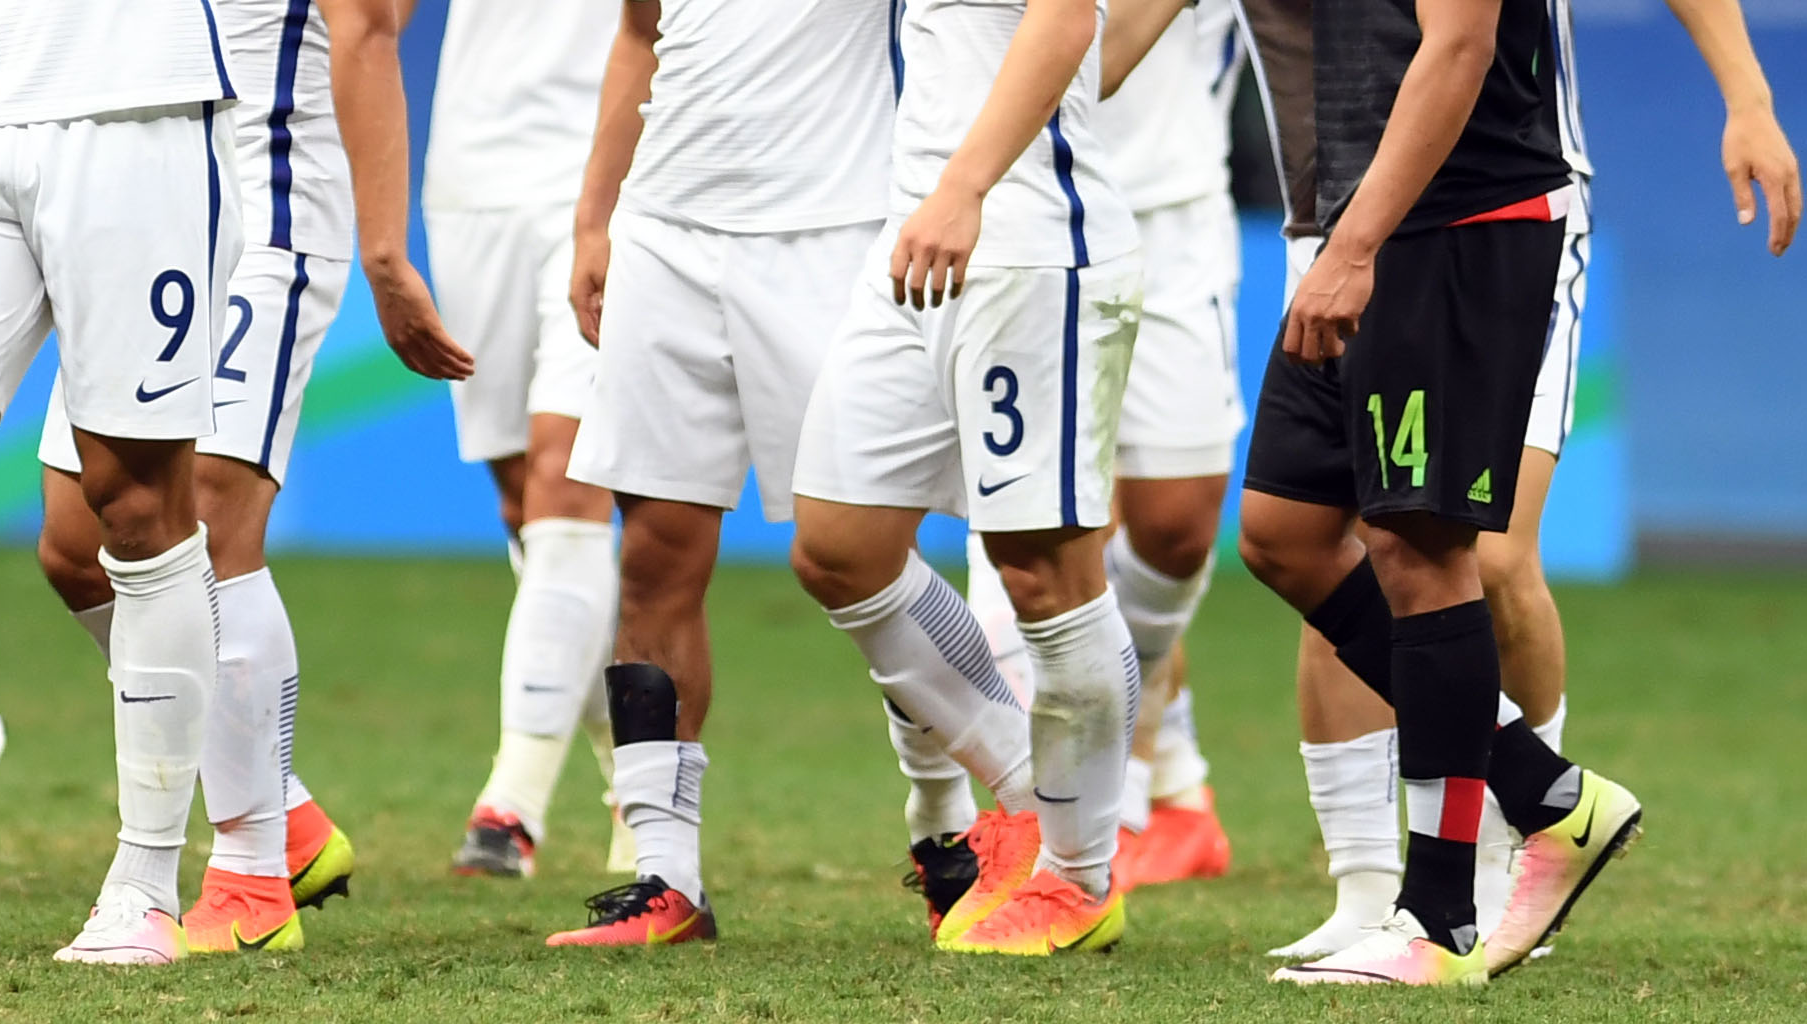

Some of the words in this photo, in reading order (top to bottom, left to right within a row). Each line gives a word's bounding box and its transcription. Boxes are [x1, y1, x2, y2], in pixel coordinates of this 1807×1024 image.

[148, 269, 196, 362] 9
[214, 295, 254, 384] 2
[981, 366, 1026, 457] 3
[1366, 389, 1430, 490] 14
